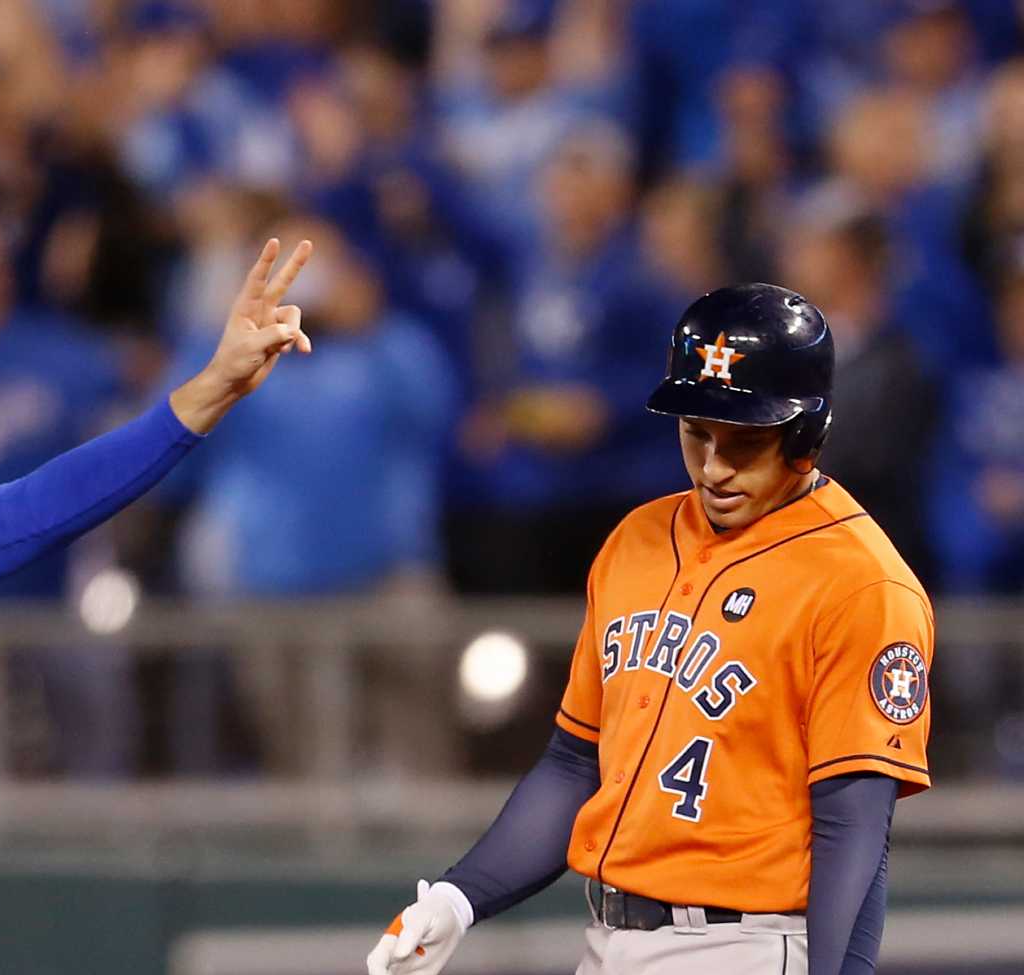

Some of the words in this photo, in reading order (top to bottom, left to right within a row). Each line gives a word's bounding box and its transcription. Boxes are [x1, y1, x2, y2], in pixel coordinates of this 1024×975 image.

[701, 343, 736, 379] H
[724, 591, 754, 616] MH
[880, 646, 924, 673] HOUSTON
[879, 698, 919, 720] ASTROS
[657, 735, 714, 823] 4
